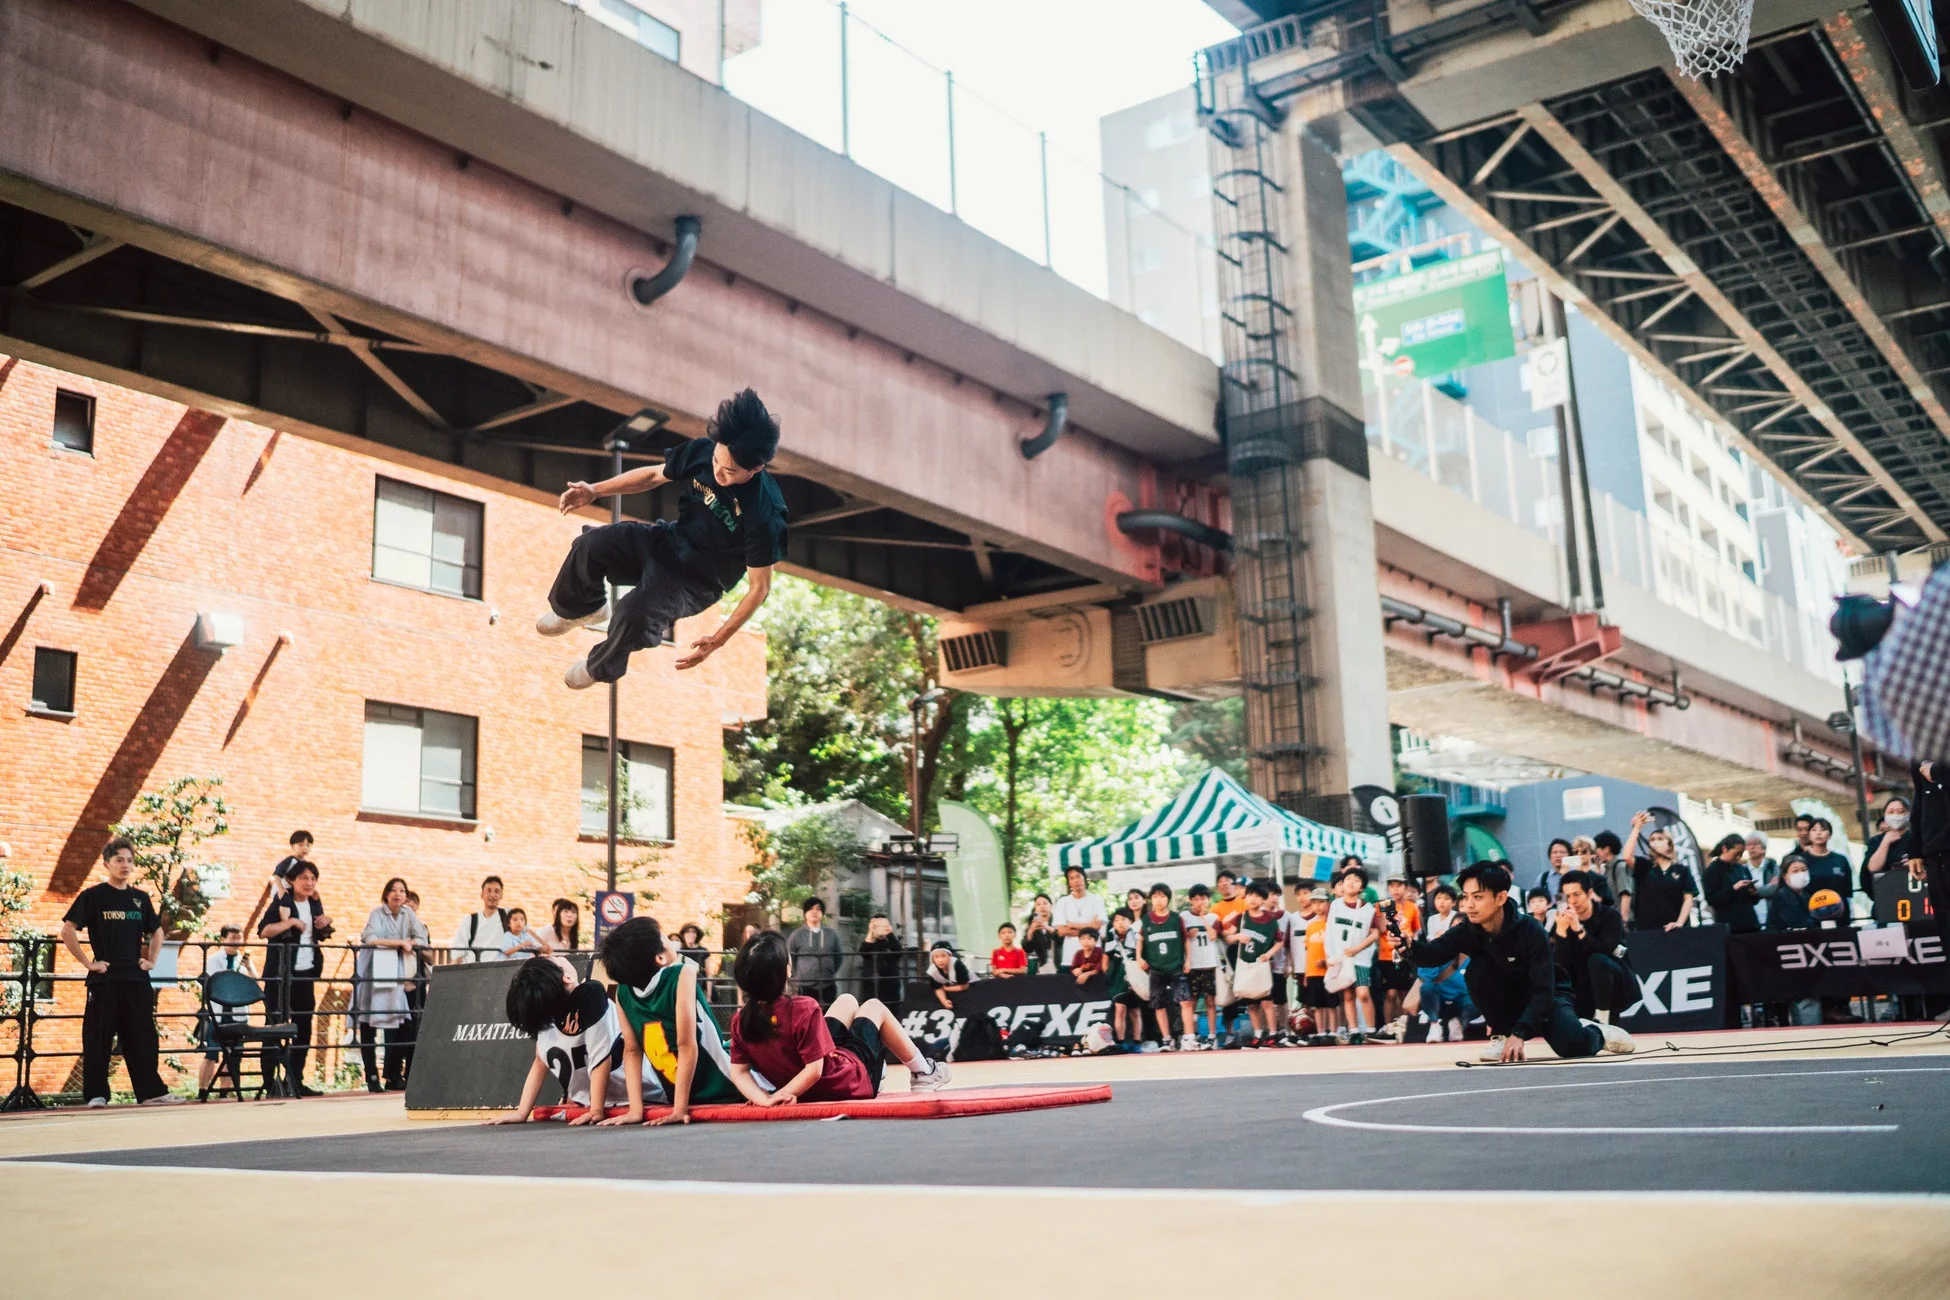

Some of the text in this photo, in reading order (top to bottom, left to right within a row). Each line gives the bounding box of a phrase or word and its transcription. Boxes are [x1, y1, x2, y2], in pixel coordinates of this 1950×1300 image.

[1897, 899, 1912, 921] 0
[1777, 935, 1947, 969] 3X3.E
[452, 1022, 532, 1042] MAXATTAC
